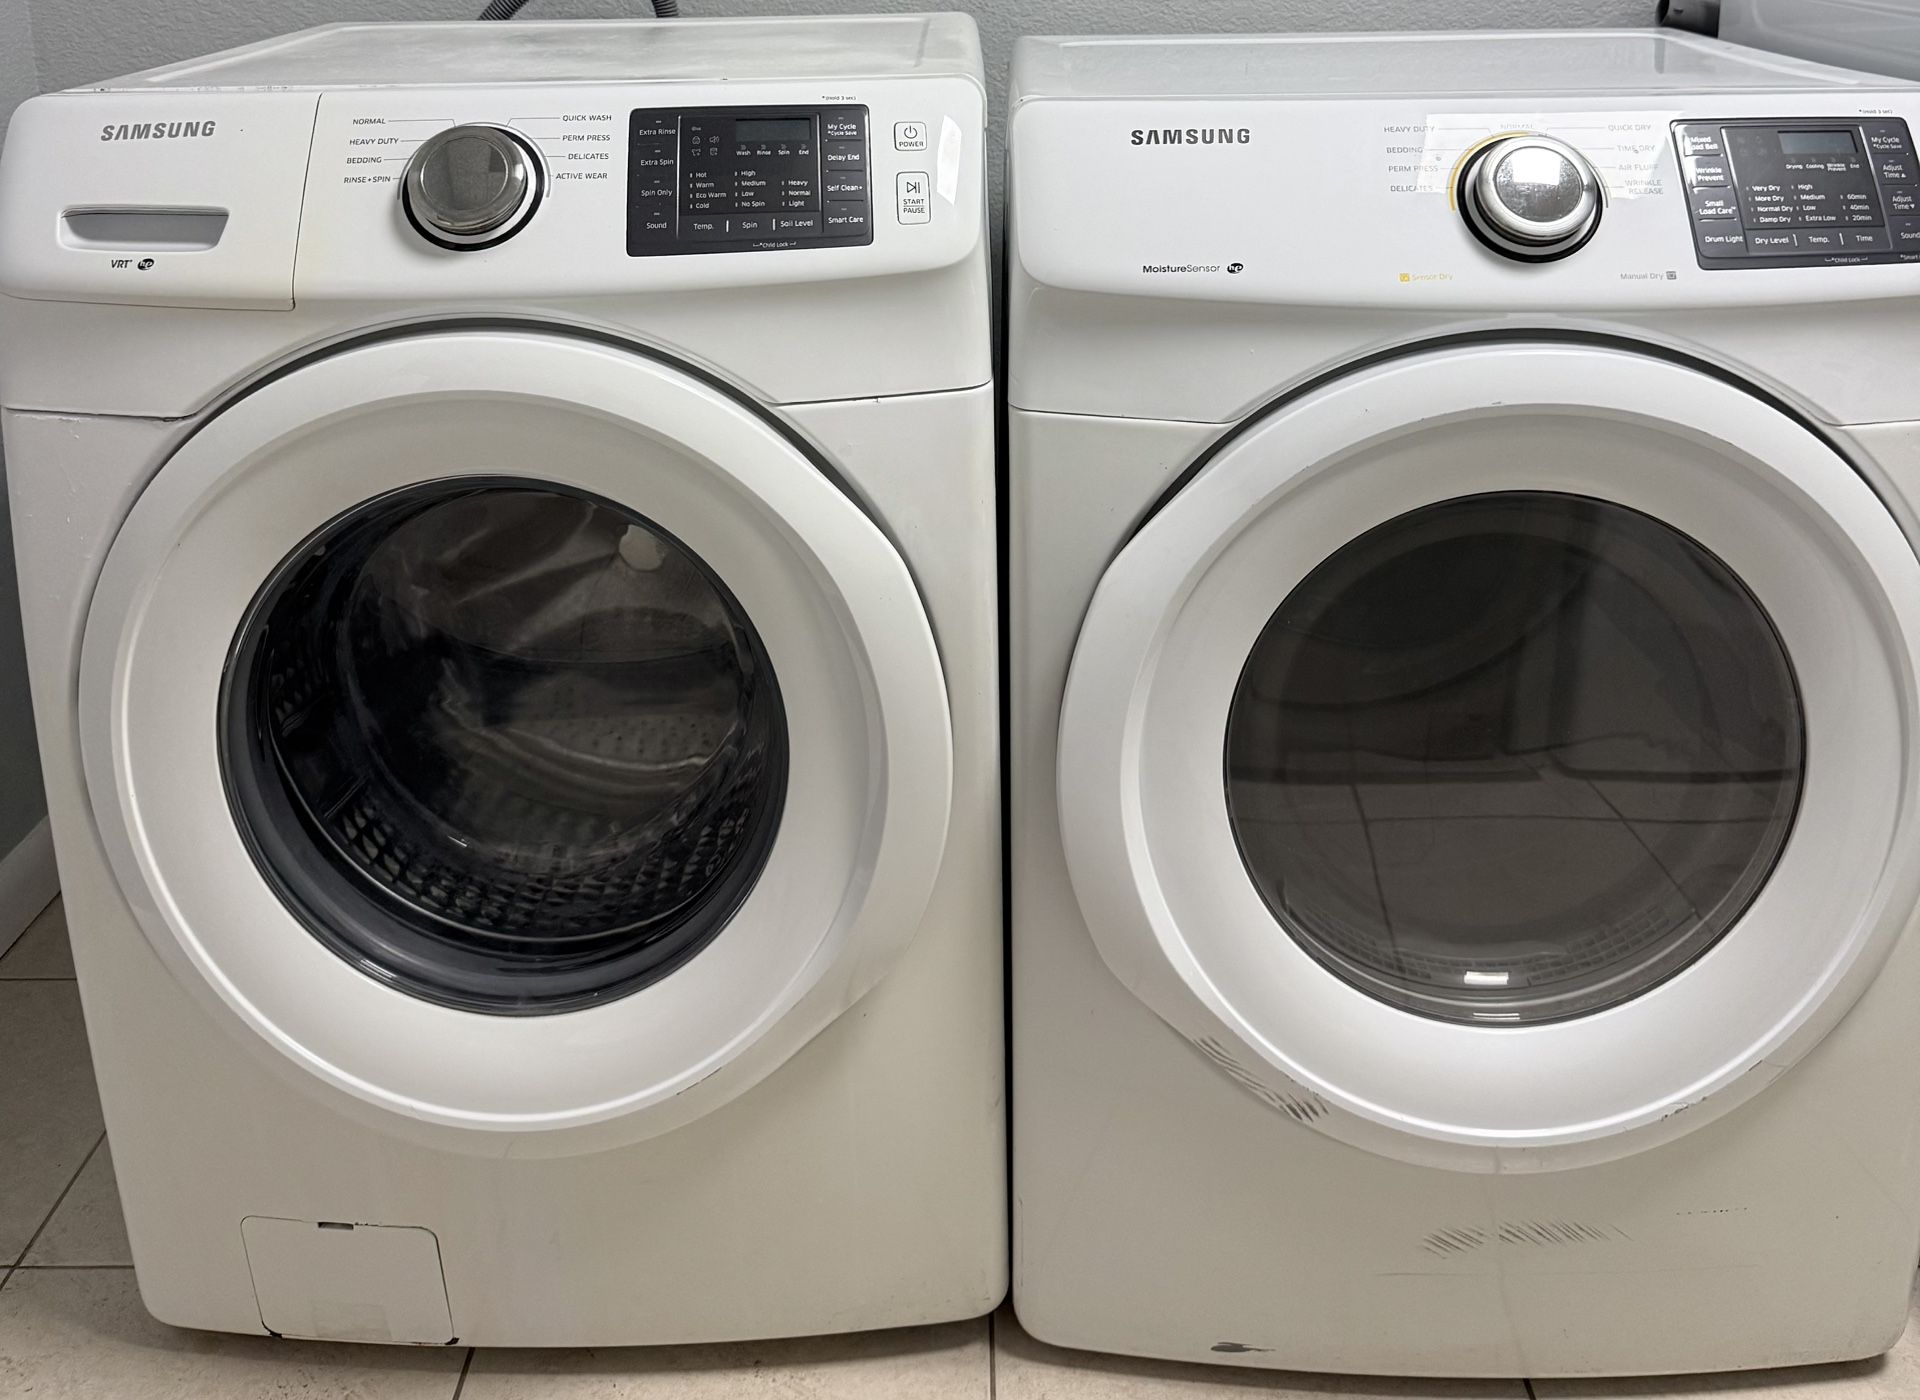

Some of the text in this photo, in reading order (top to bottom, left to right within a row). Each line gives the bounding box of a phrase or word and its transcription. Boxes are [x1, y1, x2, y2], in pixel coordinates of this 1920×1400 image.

[562, 114, 586, 122] QUICK
[101, 120, 216, 141] SAMSUNG
[562, 134, 583, 142] PERM
[1131, 128, 1250, 146] SAMSUNG
[349, 137, 399, 146] HEAVY DUTY
[346, 156, 382, 164] BEDDING
[659, 158, 674, 166] Spin
[828, 154, 846, 162] Delay
[641, 189, 673, 197] Spin Only
[742, 222, 758, 230] Spin
[1726, 235, 1743, 243] Light
[1755, 237, 1768, 245] Dry
[1142, 264, 1220, 273] MoistureSensor
[1649, 272, 1663, 281] Dry
